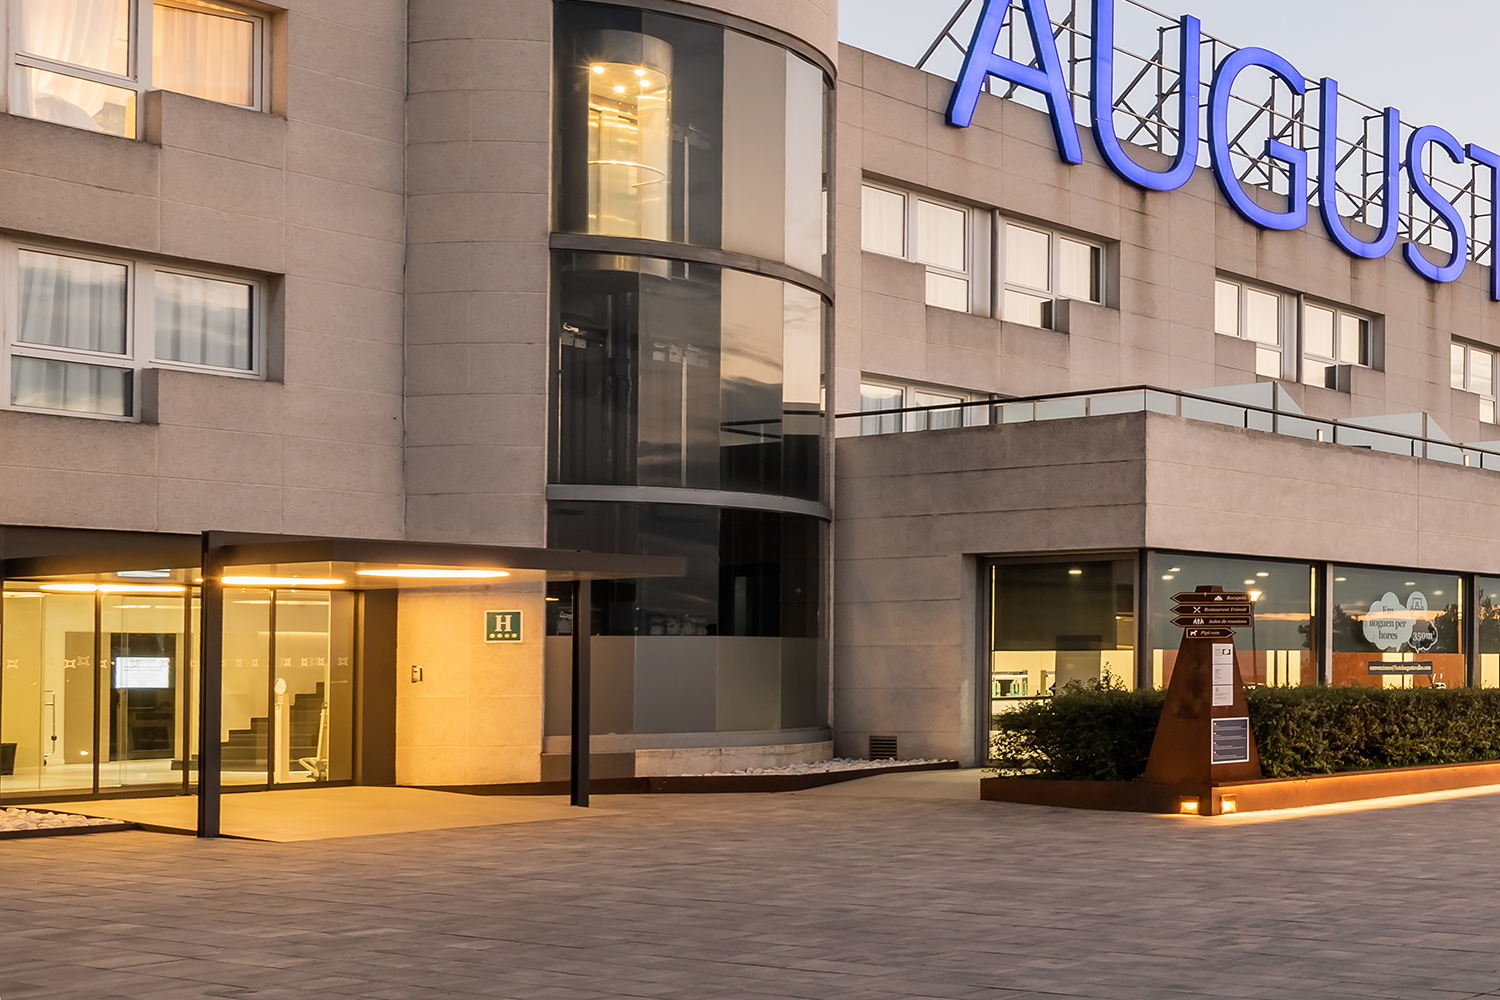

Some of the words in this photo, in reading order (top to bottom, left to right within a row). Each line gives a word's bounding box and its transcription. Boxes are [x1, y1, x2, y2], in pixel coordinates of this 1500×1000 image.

[494, 614, 513, 632] H
[1395, 620, 1407, 630] per
[1378, 630, 1398, 640] hores
